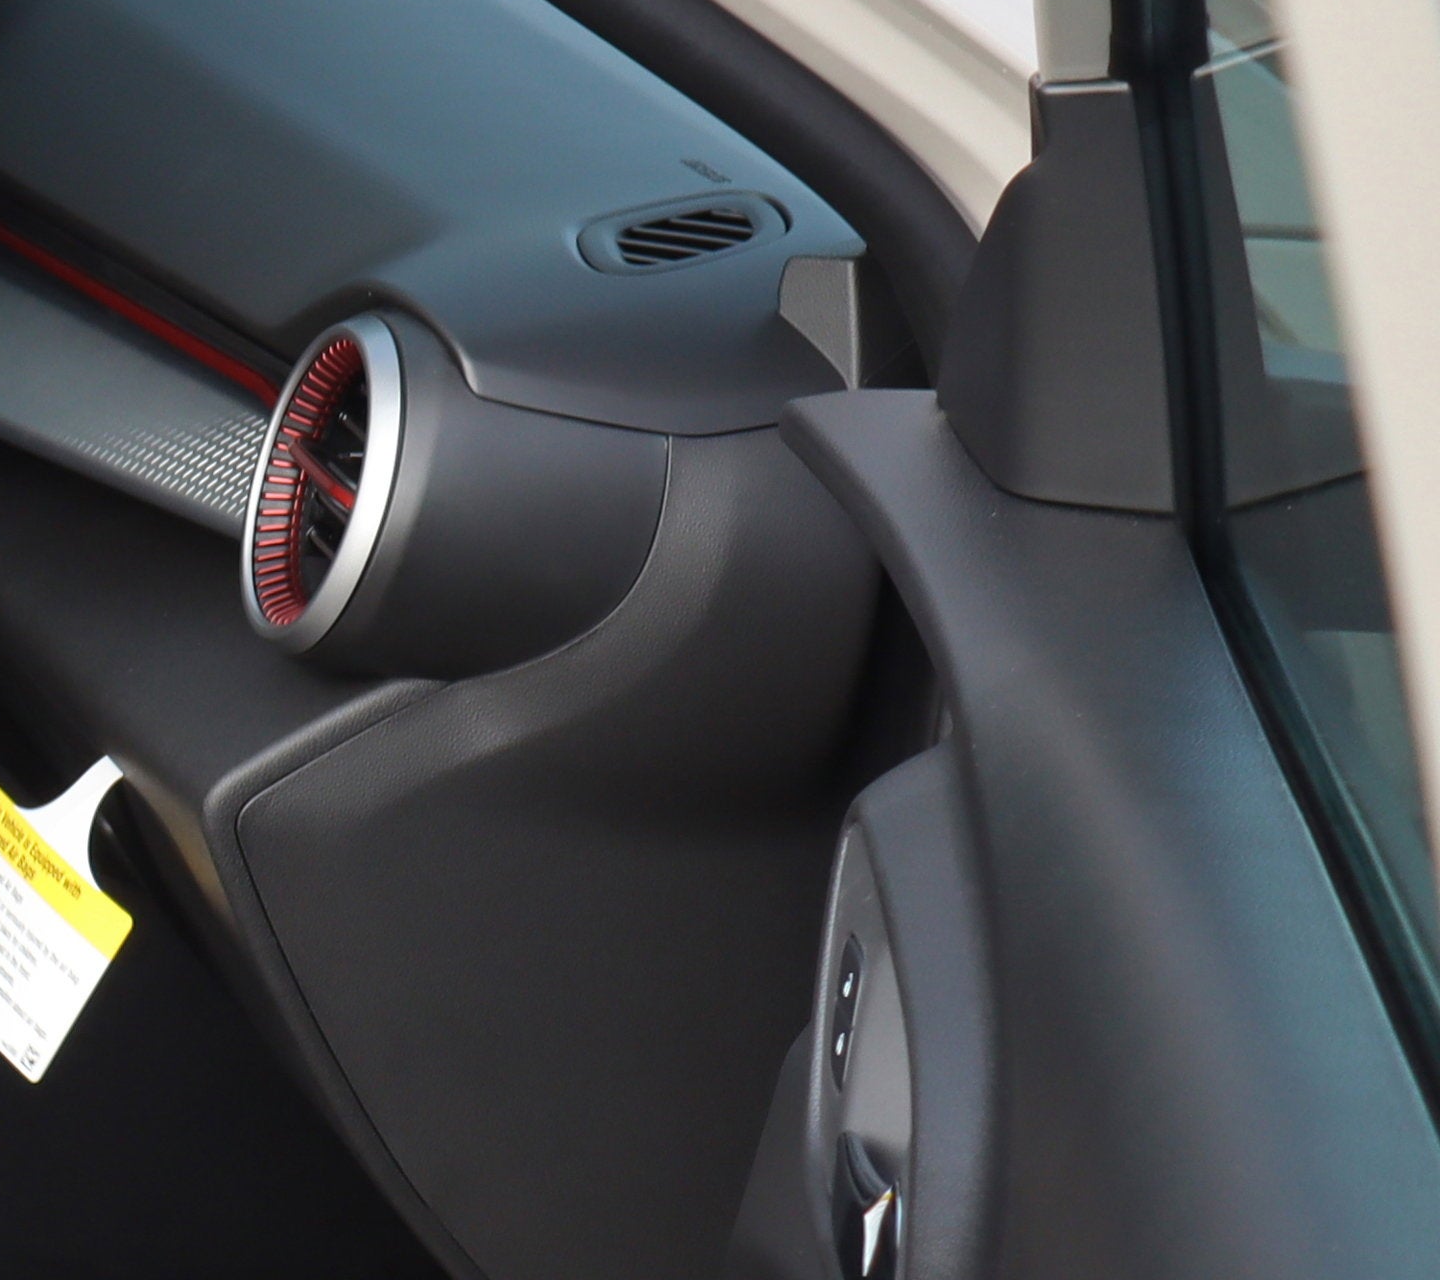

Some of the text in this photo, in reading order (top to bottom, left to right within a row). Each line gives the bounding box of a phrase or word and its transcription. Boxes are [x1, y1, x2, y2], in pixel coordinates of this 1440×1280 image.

[1, 811, 25, 843] Vehicle
[30, 842, 64, 882] Equipped
[63, 877, 82, 900] with
[17, 855, 36, 881] Bags
